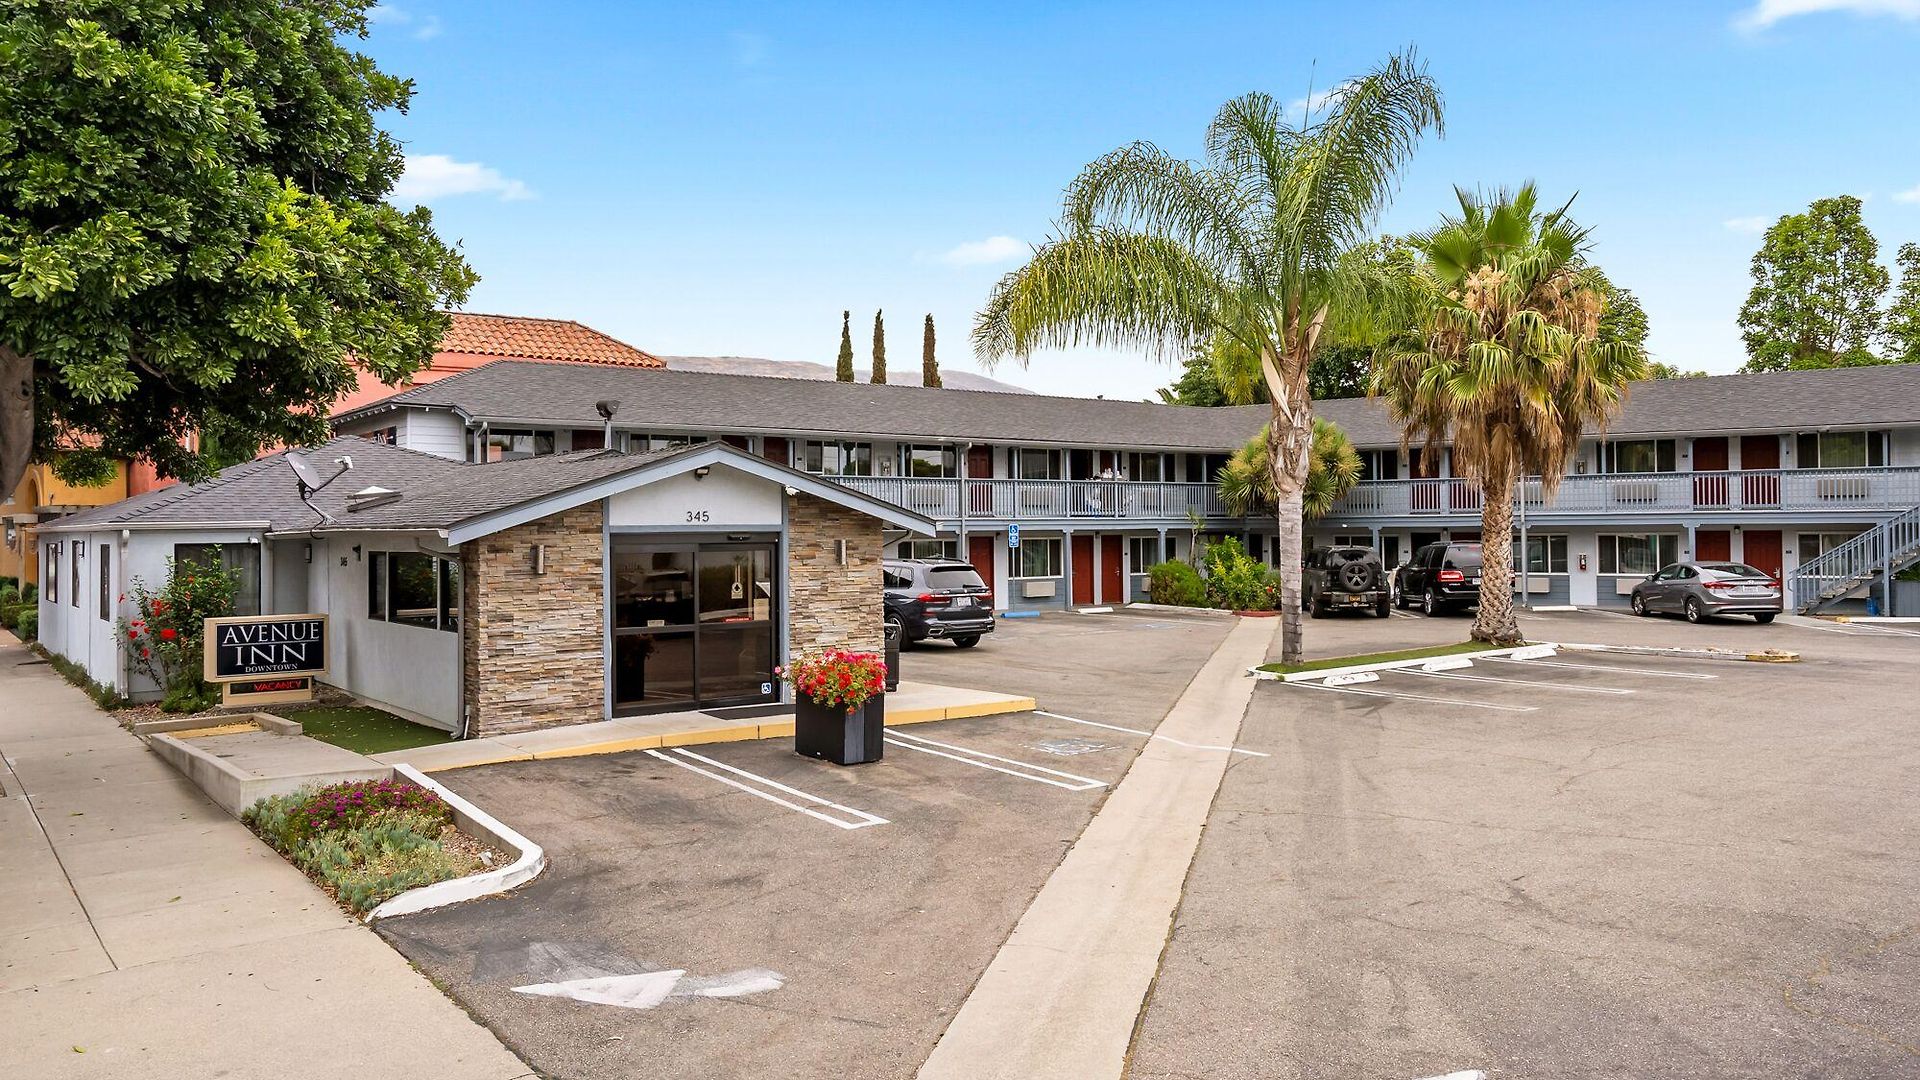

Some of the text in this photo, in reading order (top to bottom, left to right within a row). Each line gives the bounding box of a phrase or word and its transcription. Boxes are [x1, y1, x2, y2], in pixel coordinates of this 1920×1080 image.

[686, 510, 710, 523] 345
[223, 622, 320, 644] AVENUE
[235, 643, 307, 666] INN
[245, 663, 298, 673] DOWNTOWN
[253, 680, 302, 691] VACANCY
